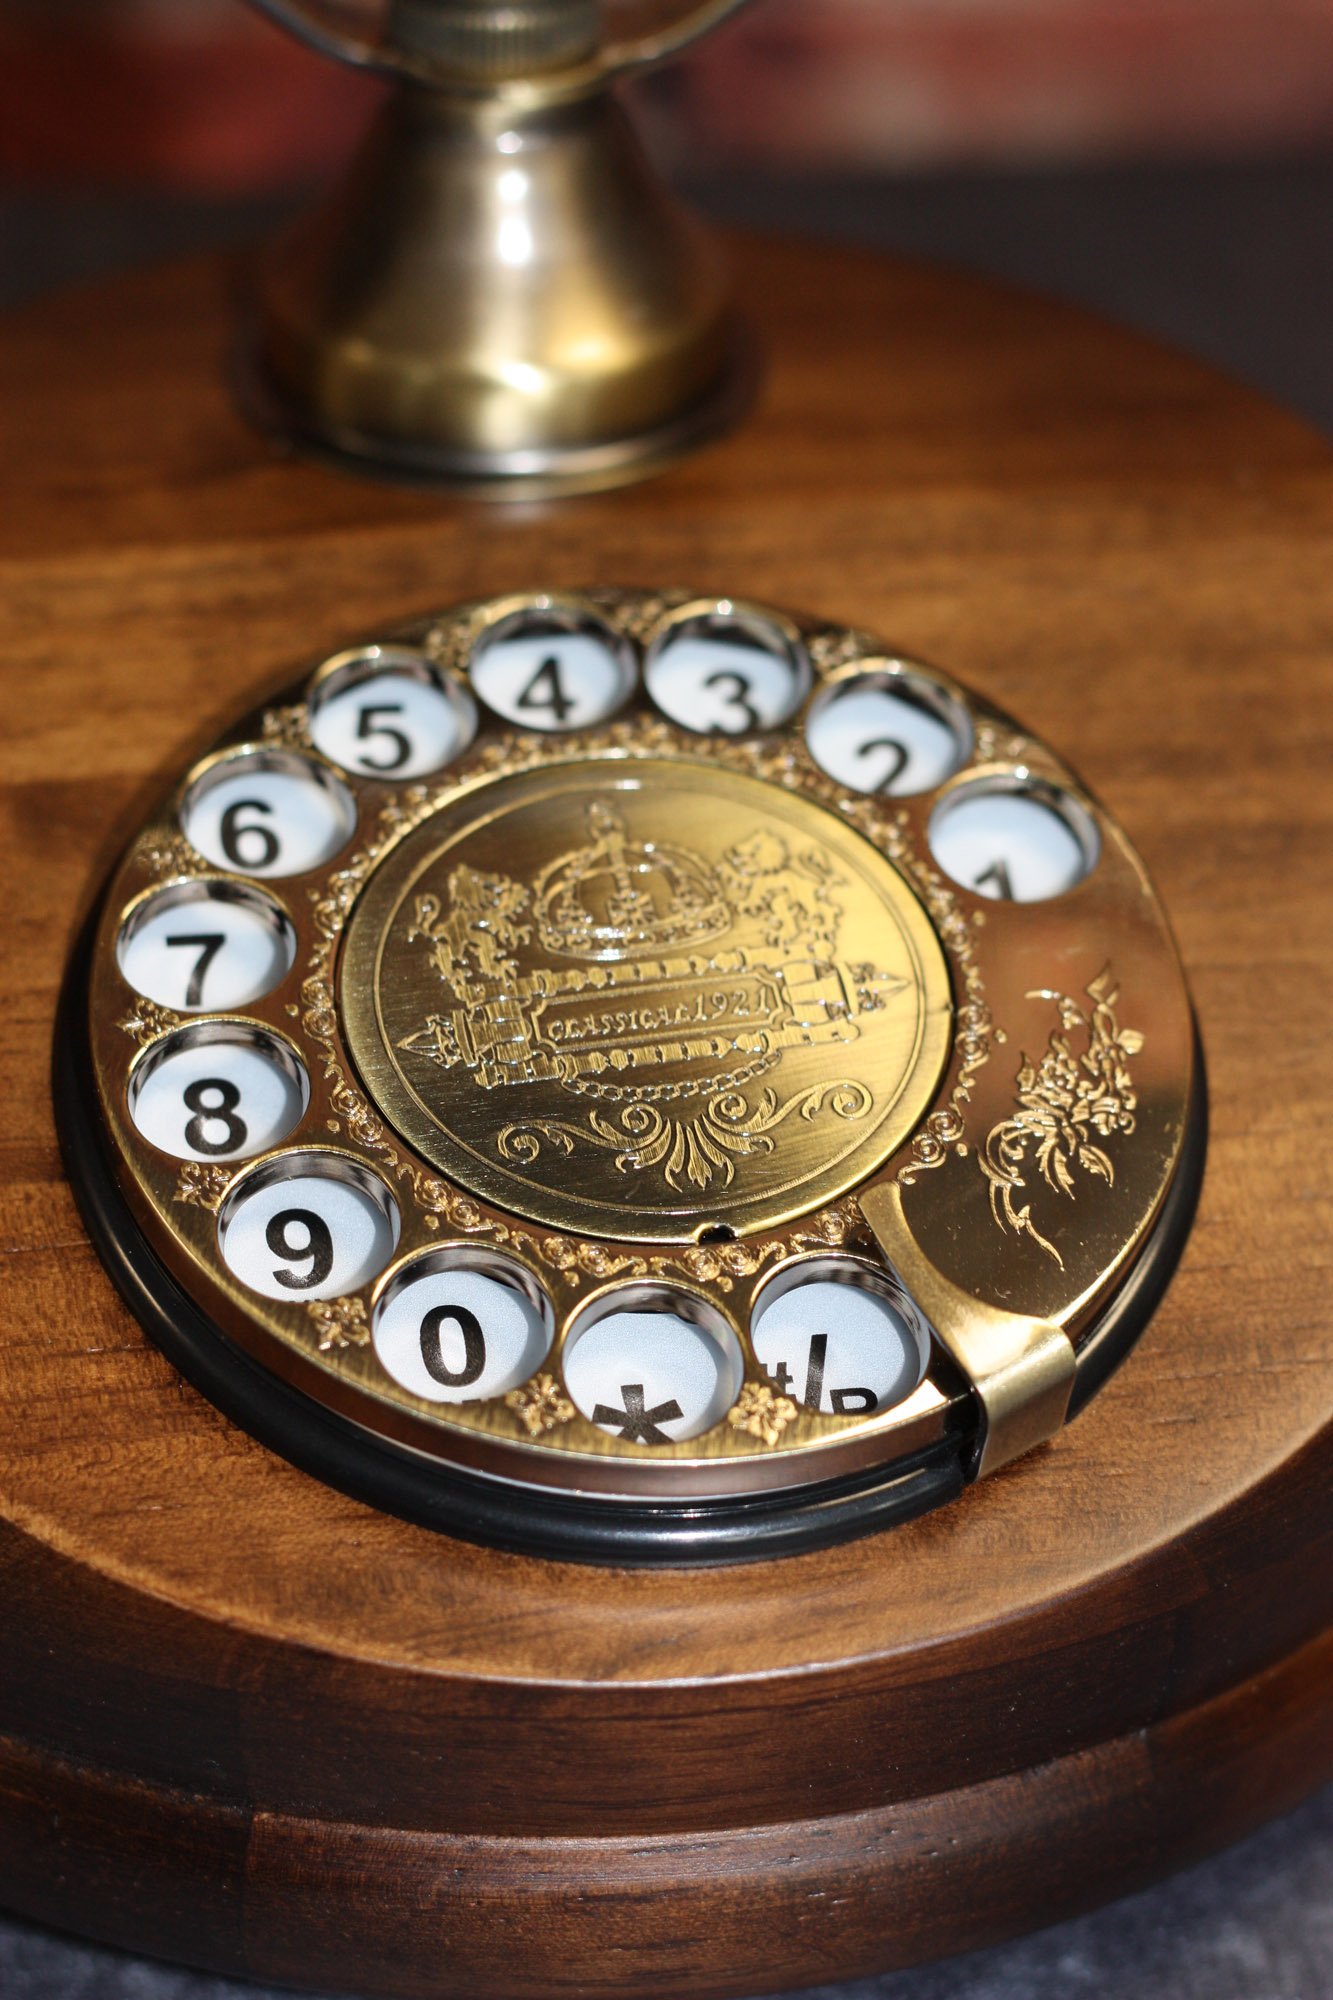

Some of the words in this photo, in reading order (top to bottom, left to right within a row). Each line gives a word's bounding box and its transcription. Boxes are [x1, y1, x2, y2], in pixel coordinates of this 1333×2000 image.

[517, 655, 576, 722] 4
[703, 671, 759, 737] 3
[355, 704, 412, 771] 5
[857, 739, 909, 797] 2
[219, 800, 281, 869] 6
[166, 933, 227, 1007] 7
[182, 1078, 248, 1157] 8
[266, 1208, 334, 1291] 9
[420, 1304, 487, 1389] 0
